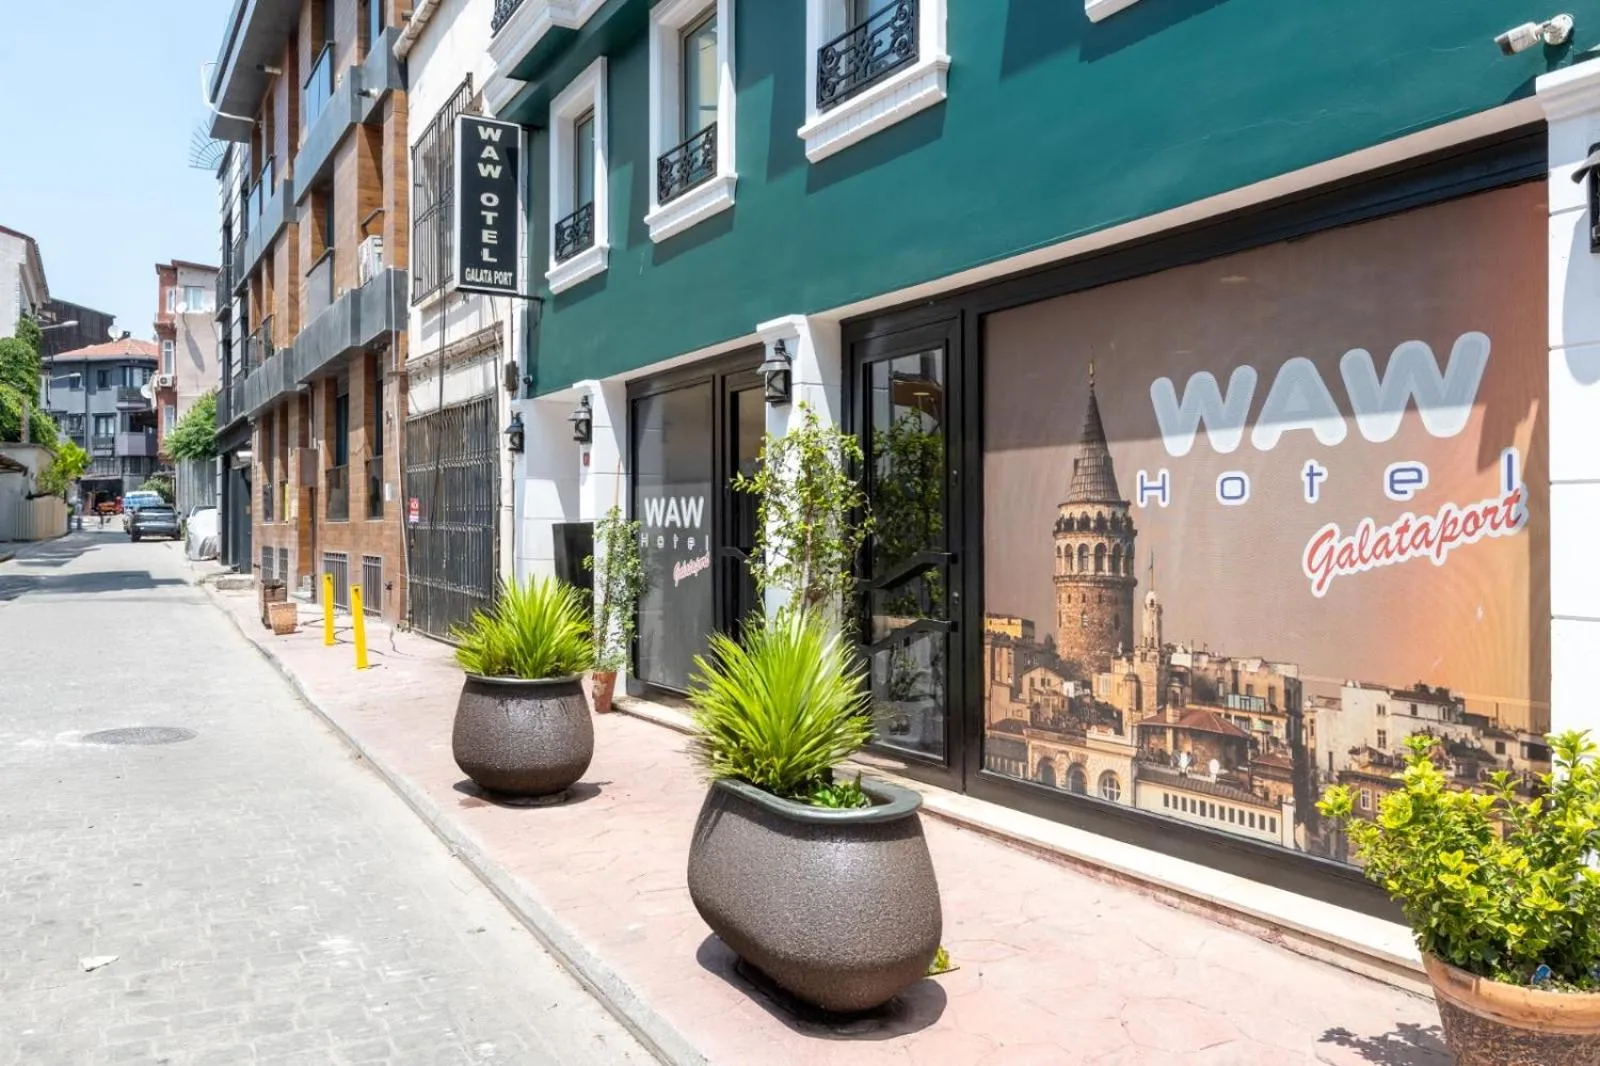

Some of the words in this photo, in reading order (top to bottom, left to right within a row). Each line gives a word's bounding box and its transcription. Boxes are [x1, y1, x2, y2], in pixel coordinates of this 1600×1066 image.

[477, 125, 502, 179] WAW
[480, 192, 499, 263] OTEL
[465, 267, 493, 284] GALATA
[493, 271, 513, 286] PORT
[1150, 331, 1491, 457] WAW
[1137, 447, 1520, 508] Hotel
[644, 496, 705, 528] WAW
[1305, 485, 1526, 595] Galataport
